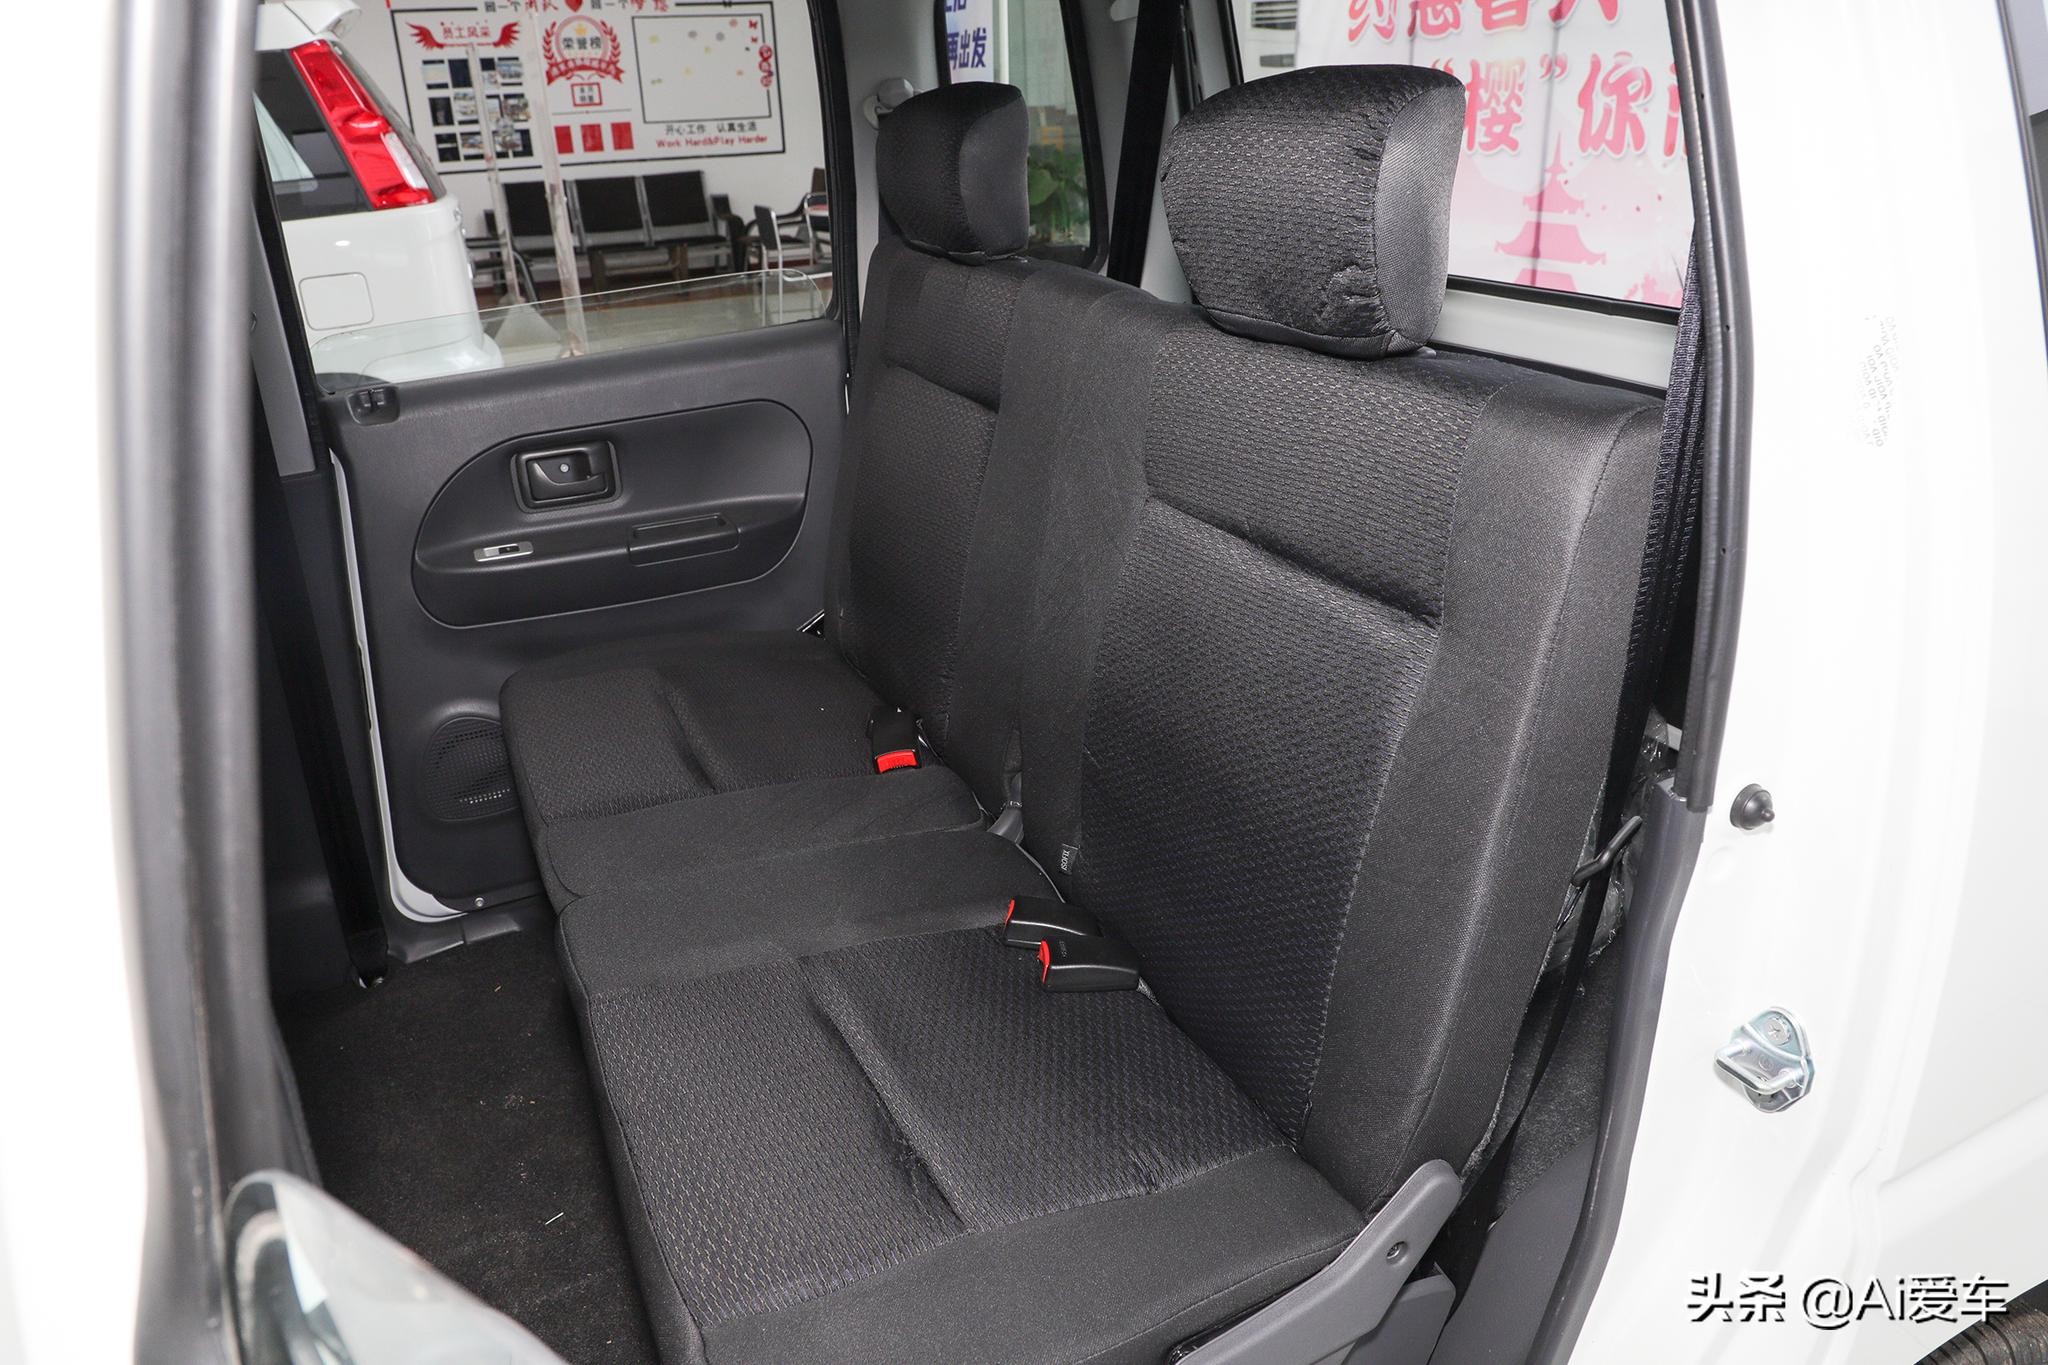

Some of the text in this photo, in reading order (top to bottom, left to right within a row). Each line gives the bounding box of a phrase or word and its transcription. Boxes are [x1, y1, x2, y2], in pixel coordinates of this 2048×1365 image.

[563, 36, 602, 50] 荣誉榜
[656, 138, 681, 148] Work
[738, 134, 768, 144] Harder
